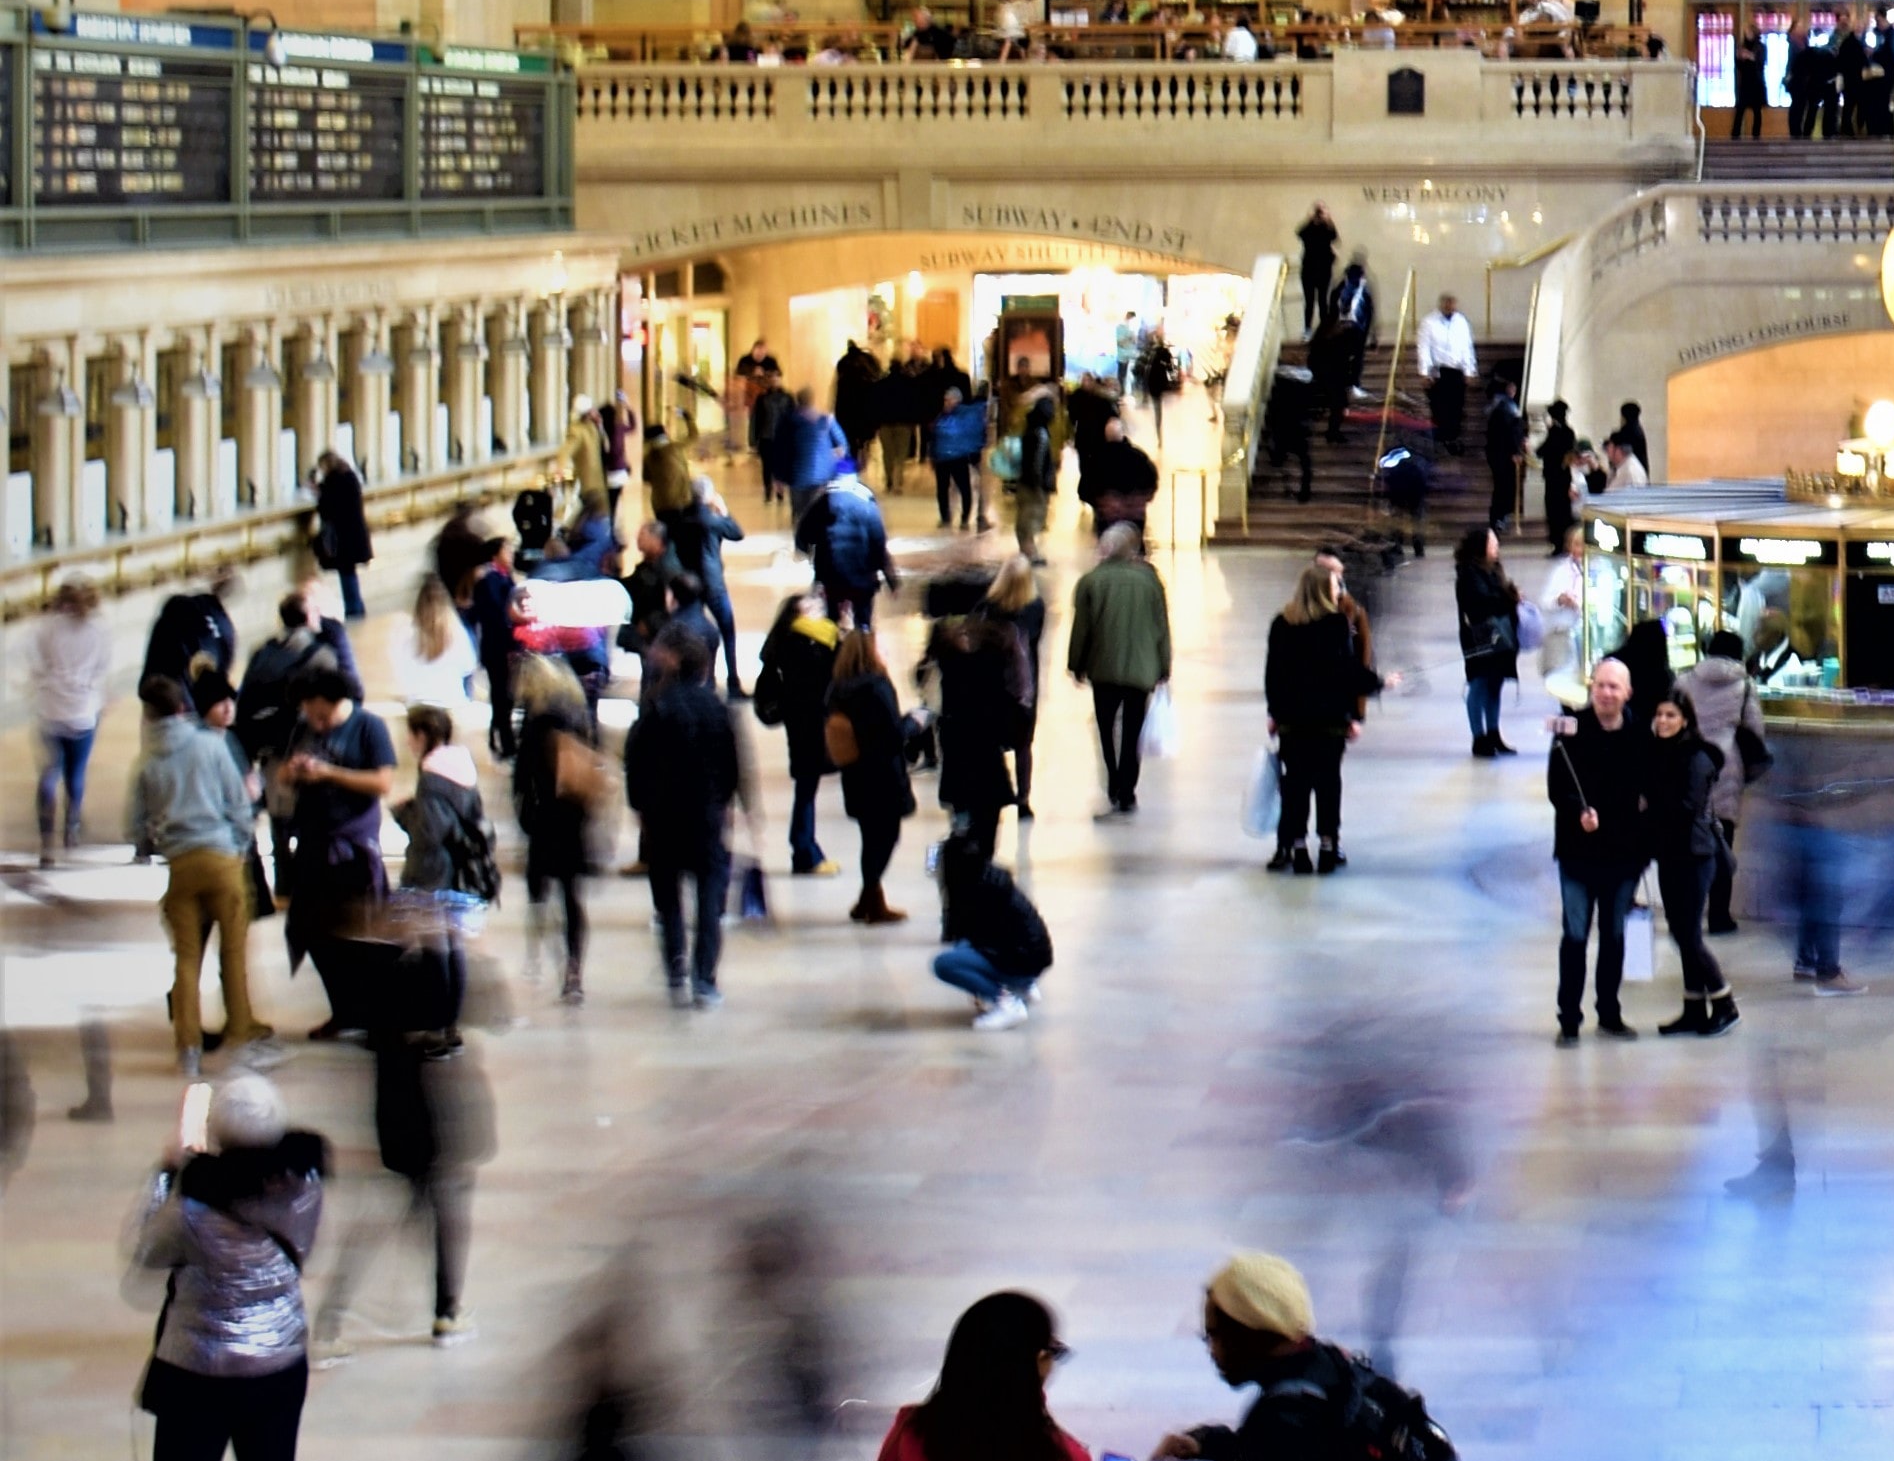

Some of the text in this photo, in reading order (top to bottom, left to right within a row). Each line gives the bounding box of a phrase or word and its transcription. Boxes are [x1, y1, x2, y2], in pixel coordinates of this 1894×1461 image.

[1363, 185, 1509, 203] WEST BALCONY
[733, 201, 871, 235] MACHINES
[963, 204, 1192, 252] SUBWAY 42ND ST
[920, 246, 1007, 268] SUBWAY
[1678, 309, 1850, 365] DINING CONCOURSE
